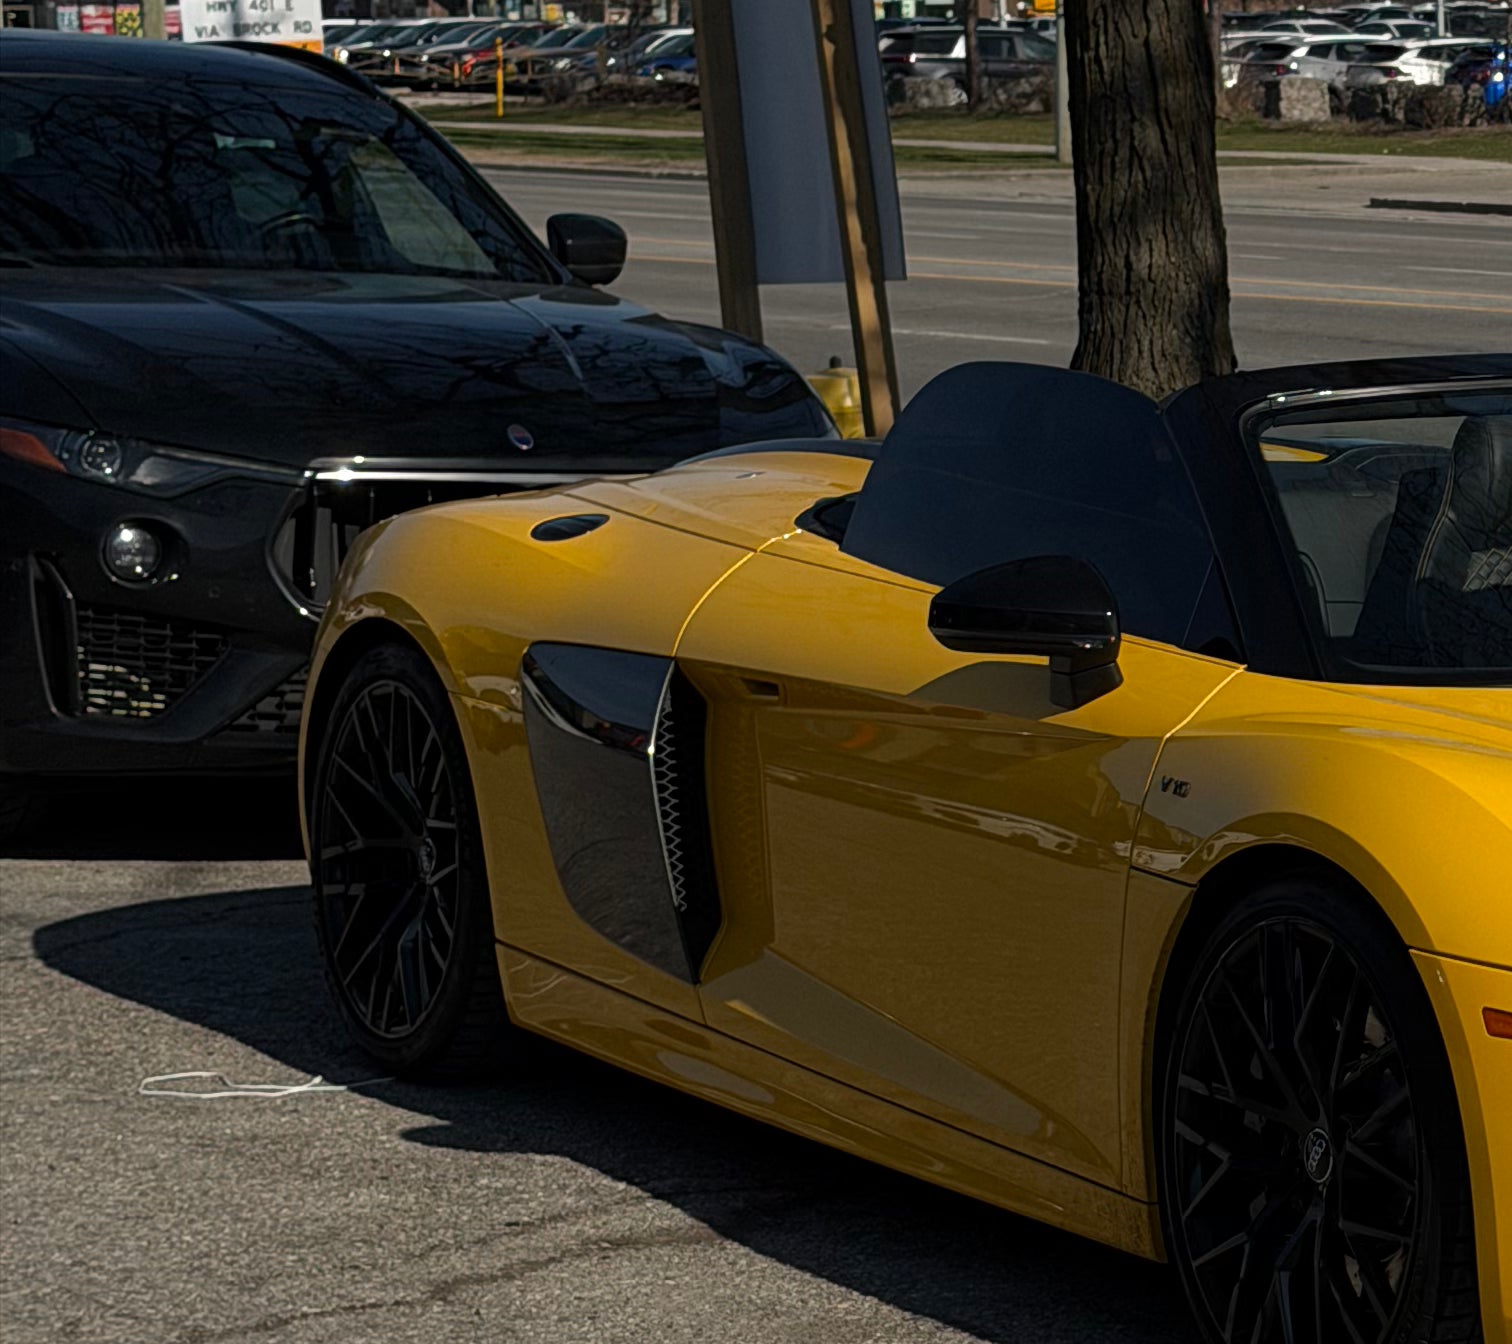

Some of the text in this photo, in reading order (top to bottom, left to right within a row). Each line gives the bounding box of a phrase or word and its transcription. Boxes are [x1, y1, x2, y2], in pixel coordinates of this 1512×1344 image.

[195, 20, 313, 38] VIA BROCK RD
[1161, 775, 1191, 798] V10
